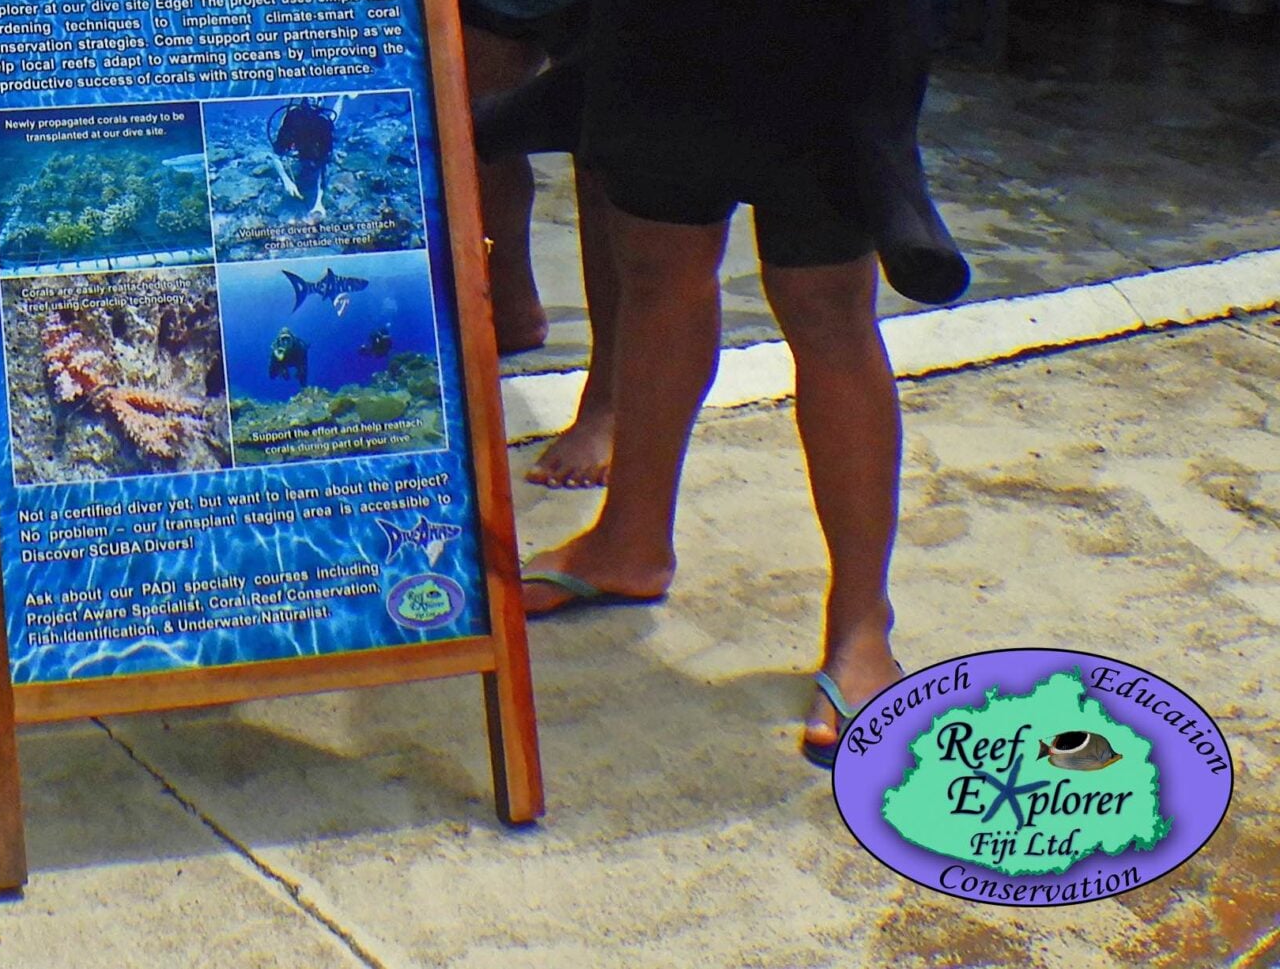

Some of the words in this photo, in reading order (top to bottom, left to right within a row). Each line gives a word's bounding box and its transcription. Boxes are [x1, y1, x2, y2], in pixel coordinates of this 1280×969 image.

[44, 2, 57, 13] at
[62, 3, 85, 12] our
[91, 0, 118, 11] dive
[65, 18, 140, 34] techniques
[154, 16, 168, 27] to
[182, 13, 252, 29] implement
[265, 9, 354, 22] climate-smart
[367, 7, 400, 18] coral
[78, 36, 148, 52] strategies.
[154, 34, 192, 46] Come
[198, 31, 250, 46] support
[255, 33, 278, 41] our
[283, 27, 358, 43] partnership
[363, 28, 378, 37] as
[383, 27, 401, 36] we
[21, 58, 54, 70] local
[61, 57, 95, 69] reefs
[103, 55, 141, 69] adapt
[148, 54, 161, 65] to
[169, 51, 226, 66] warming
[233, 51, 280, 61] oceans
[288, 47, 304, 61] by
[311, 44, 377, 60] improving
[383, 43, 403, 54] the
[77, 76, 132, 86] success
[136, 73, 151, 84] of
[154, 71, 195, 83] corals
[199, 69, 227, 81] with
[231, 67, 274, 82] strong
[278, 66, 306, 77] heat
[309, 63, 373, 75] tolerance.
[5, 119, 35, 131] Newly
[38, 116, 94, 129] propagated
[97, 114, 127, 124] corals
[129, 113, 157, 124] ready
[159, 112, 170, 121] to
[172, 111, 184, 120] be
[26, 130, 89, 143] transplanted
[90, 130, 100, 138] at
[122, 128, 143, 137] dive
[145, 126, 166, 135] site.
[238, 226, 284, 237] Volunteer
[287, 224, 318, 234] divers
[319, 223, 340, 234] help
[356, 219, 395, 230] reattach
[252, 429, 291, 443] Support
[293, 428, 308, 437] the
[313, 425, 338, 436] effort
[340, 424, 358, 434] and
[360, 422, 382, 434] help
[384, 419, 422, 430] reattach
[18, 509, 44, 523] Not
[50, 510, 57, 520] a
[63, 502, 121, 519] certified
[127, 499, 162, 513] diver
[168, 496, 193, 512] yet,
[199, 494, 221, 507] but
[227, 490, 260, 504] want
[265, 489, 280, 501] to
[285, 485, 318, 499] learn
[324, 482, 362, 496] about
[368, 479, 389, 492] the
[394, 474, 449, 492] project?
[20, 530, 40, 542] No
[49, 524, 108, 543] problem
[133, 522, 157, 532] our
[165, 512, 236, 532] transplant
[244, 507, 294, 525] staging
[302, 506, 331, 517] area
[339, 502, 352, 514] is
[359, 495, 430, 512] accessible
[437, 493, 451, 505] to
[21, 545, 85, 562] Discover
[89, 540, 141, 556] SCUBA
[144, 535, 193, 551] Divers!
[25, 592, 52, 606] Ask
[61, 587, 101, 602] about
[110, 587, 134, 598] our
[142, 580, 176, 595] PADI
[184, 574, 246, 593] specialty
[254, 571, 308, 584] courses
[316, 561, 379, 581] including
[26, 609, 83, 628] Project
[82, 605, 127, 620] Aware
[131, 597, 204, 618] Specialist,
[208, 593, 247, 608] Coral
[251, 590, 282, 604] Reef
[28, 631, 59, 646] Fish
[63, 622, 159, 644] Identification,
[163, 620, 173, 632] &
[178, 612, 257, 631] Underwater
[261, 605, 331, 623] Naturalist.
